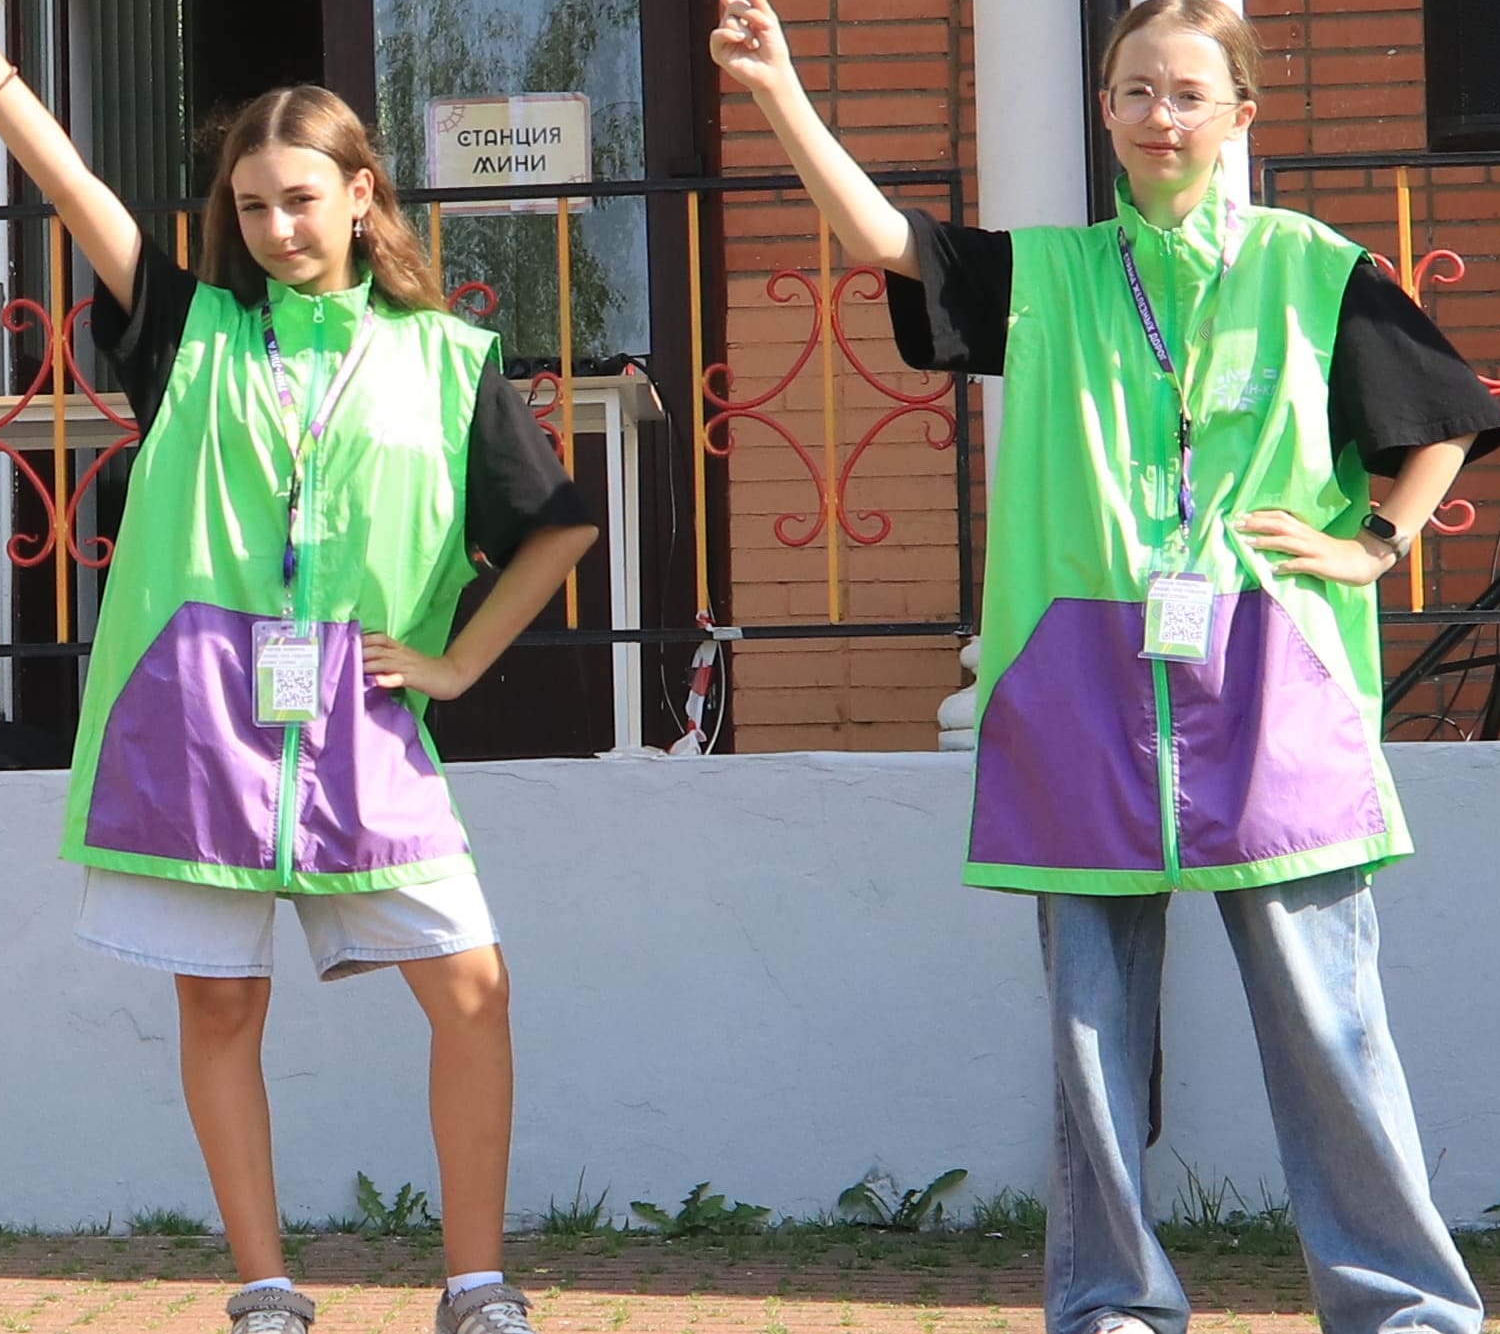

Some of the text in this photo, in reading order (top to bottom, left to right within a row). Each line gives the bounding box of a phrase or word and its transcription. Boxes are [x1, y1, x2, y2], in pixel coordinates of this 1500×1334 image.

[457, 126, 562, 147] СТАНЦИЯ
[472, 154, 547, 174] МИНИ
[1148, 332, 1168, 361] ДОРОГ
